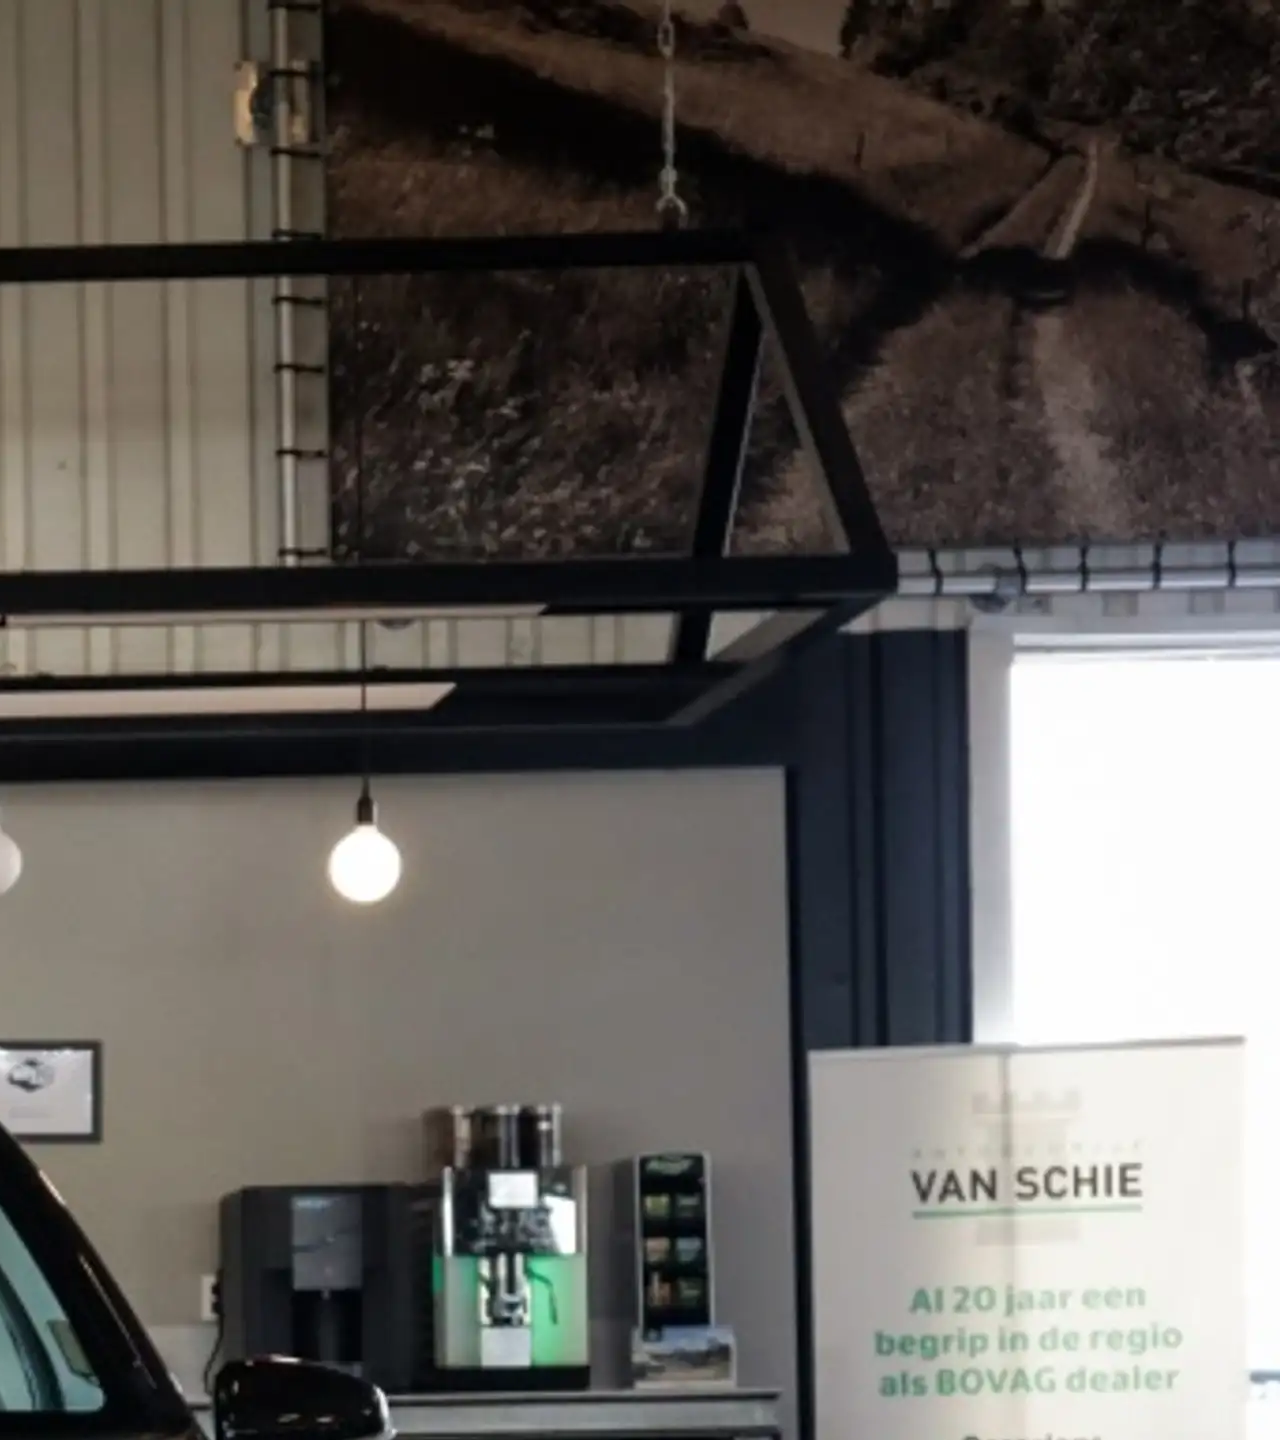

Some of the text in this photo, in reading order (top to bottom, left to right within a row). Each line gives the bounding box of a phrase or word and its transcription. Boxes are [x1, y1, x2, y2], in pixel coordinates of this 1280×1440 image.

[910, 1163, 1143, 1203] VAN SCHIE
[909, 1282, 1146, 1317] Al 20 jaar een
[874, 1321, 1183, 1360] begrip in de regio
[878, 1363, 1180, 1397] als BOVAG dealer
